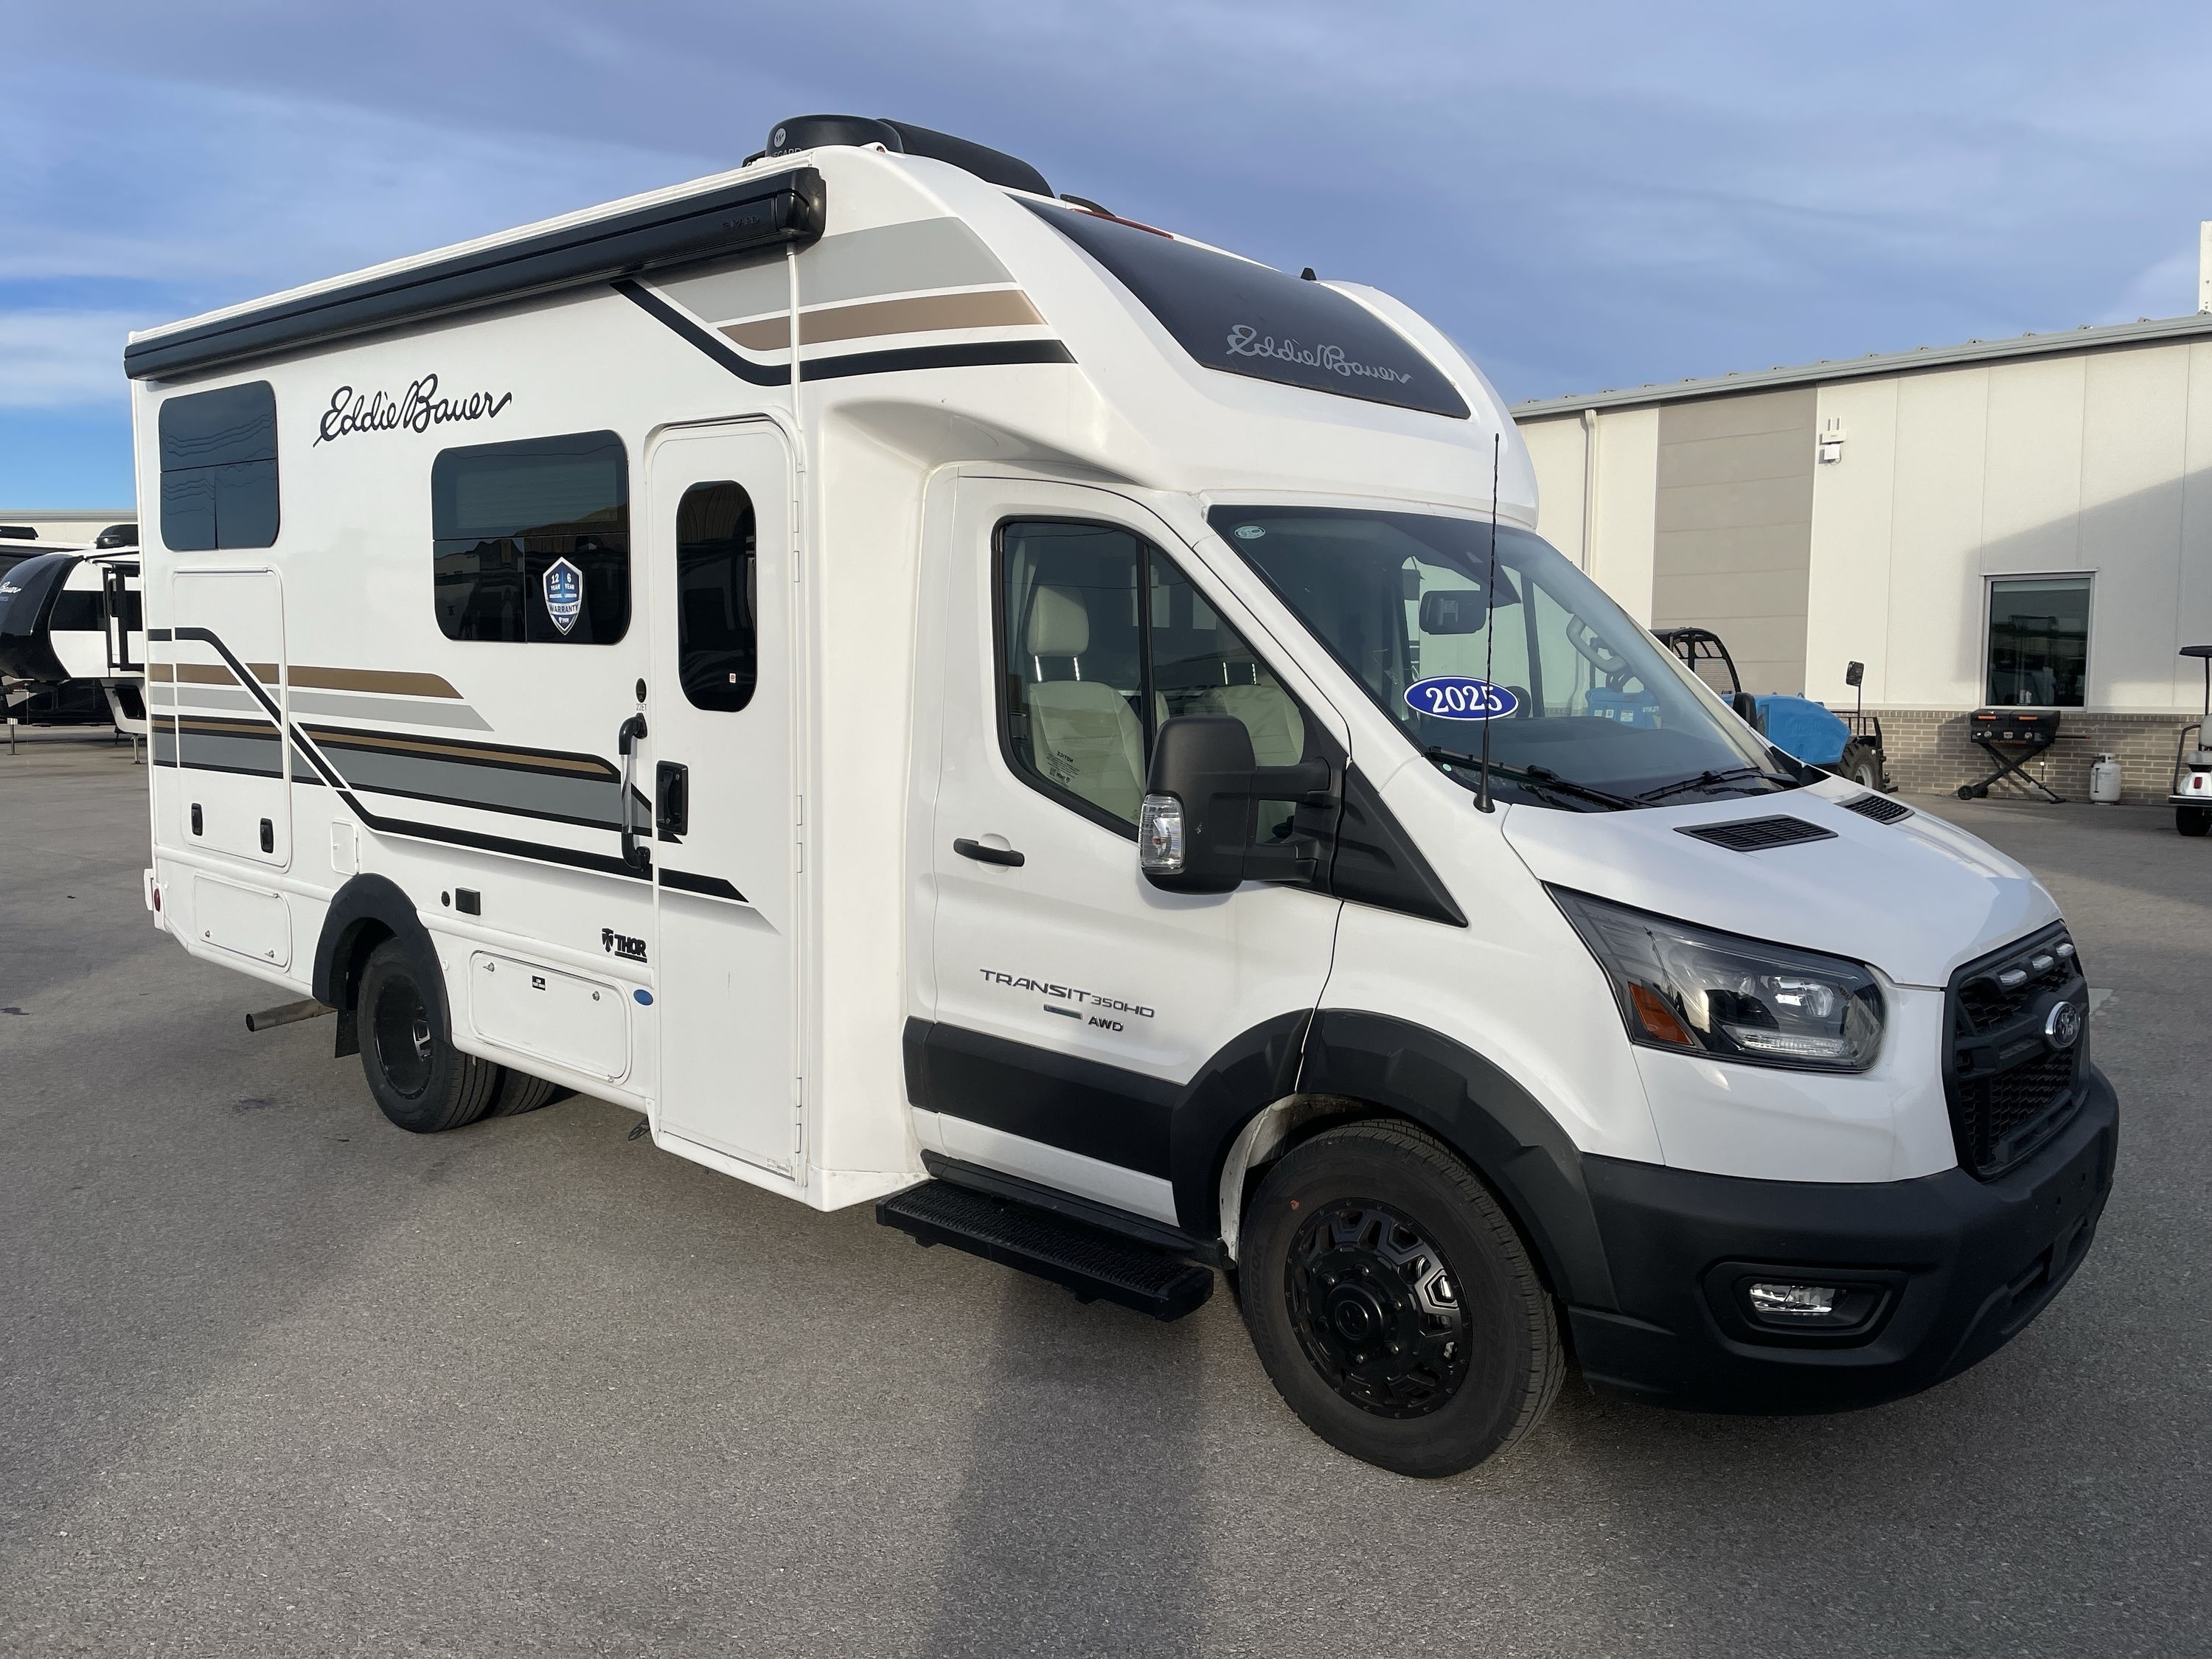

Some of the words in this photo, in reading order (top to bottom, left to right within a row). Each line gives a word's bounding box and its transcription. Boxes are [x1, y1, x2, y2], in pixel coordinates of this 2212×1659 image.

[1226, 324, 1314, 364] Eddie
[1313, 344, 1413, 384] Bauer
[313, 385, 399, 448] Eddie
[403, 373, 512, 434] Bauer
[551, 573, 560, 584] 12
[566, 572, 572, 583] 6
[550, 583, 561, 591] YEAR
[564, 582, 575, 591] YEAR
[549, 603, 579, 613] WARRANTY
[1425, 685, 1503, 713] 2025
[614, 933, 647, 958] THOR
[980, 969, 1091, 1002] TRANSIT
[1091, 995, 1155, 1018] 350HD
[1088, 1016, 1124, 1032] AWD
